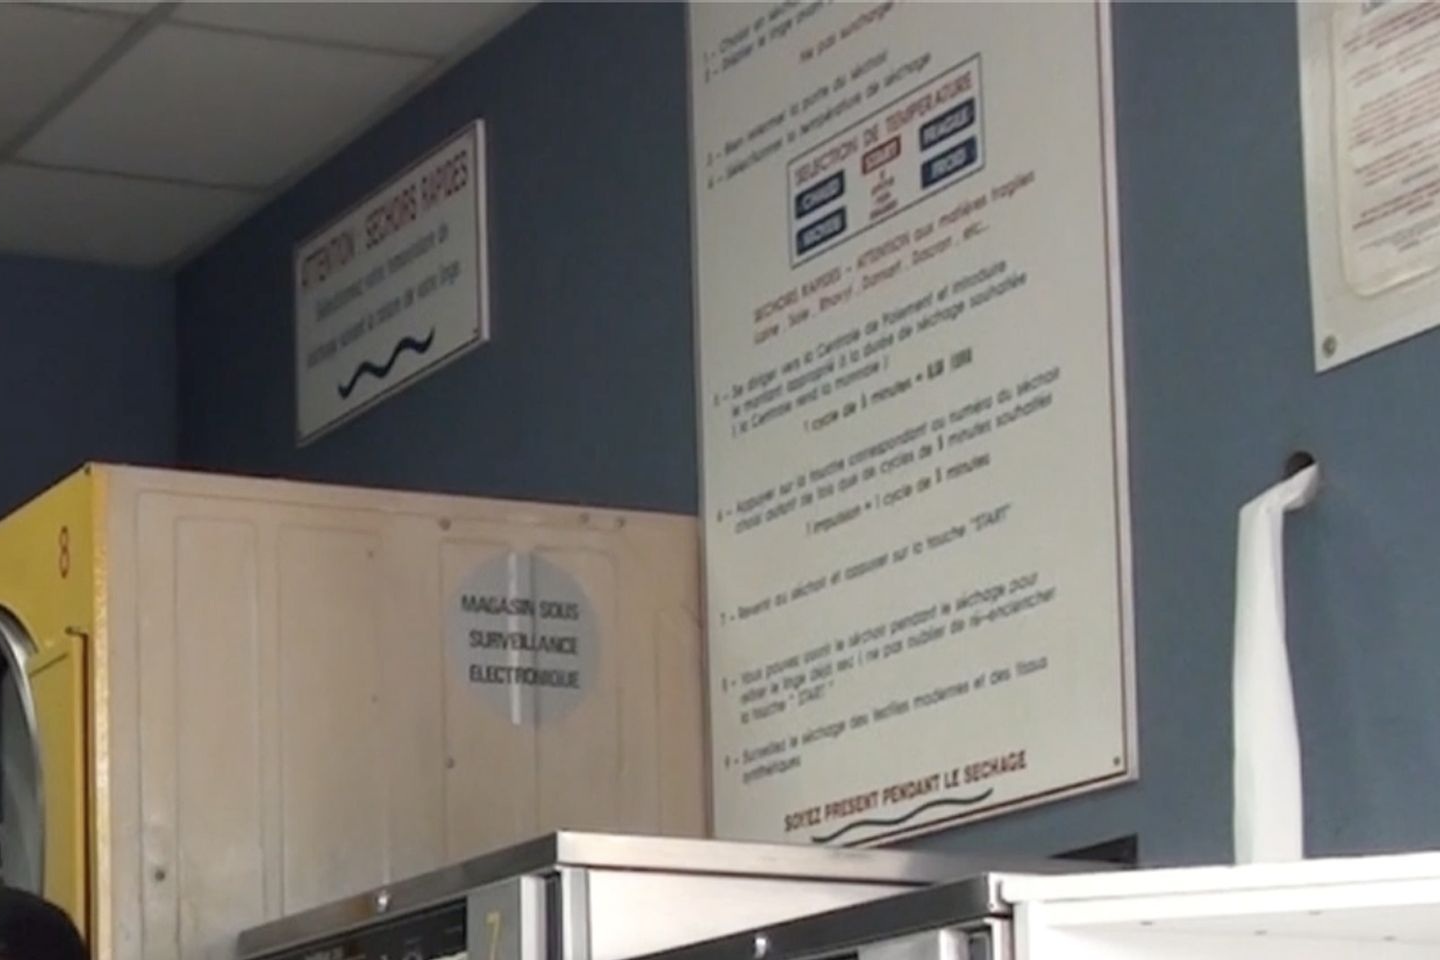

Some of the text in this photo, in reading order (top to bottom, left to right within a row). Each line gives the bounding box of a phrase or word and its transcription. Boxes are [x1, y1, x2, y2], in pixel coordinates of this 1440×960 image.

[59, 525, 71, 579] 8
[461, 594, 579, 620] MAGASIN SOUS
[468, 629, 578, 655] SURVEILLANCE
[468, 664, 581, 689] ELECTRONIQUE
[783, 748, 1027, 832] SOYEZ PRESENT PENDANT LE SECHAGE
